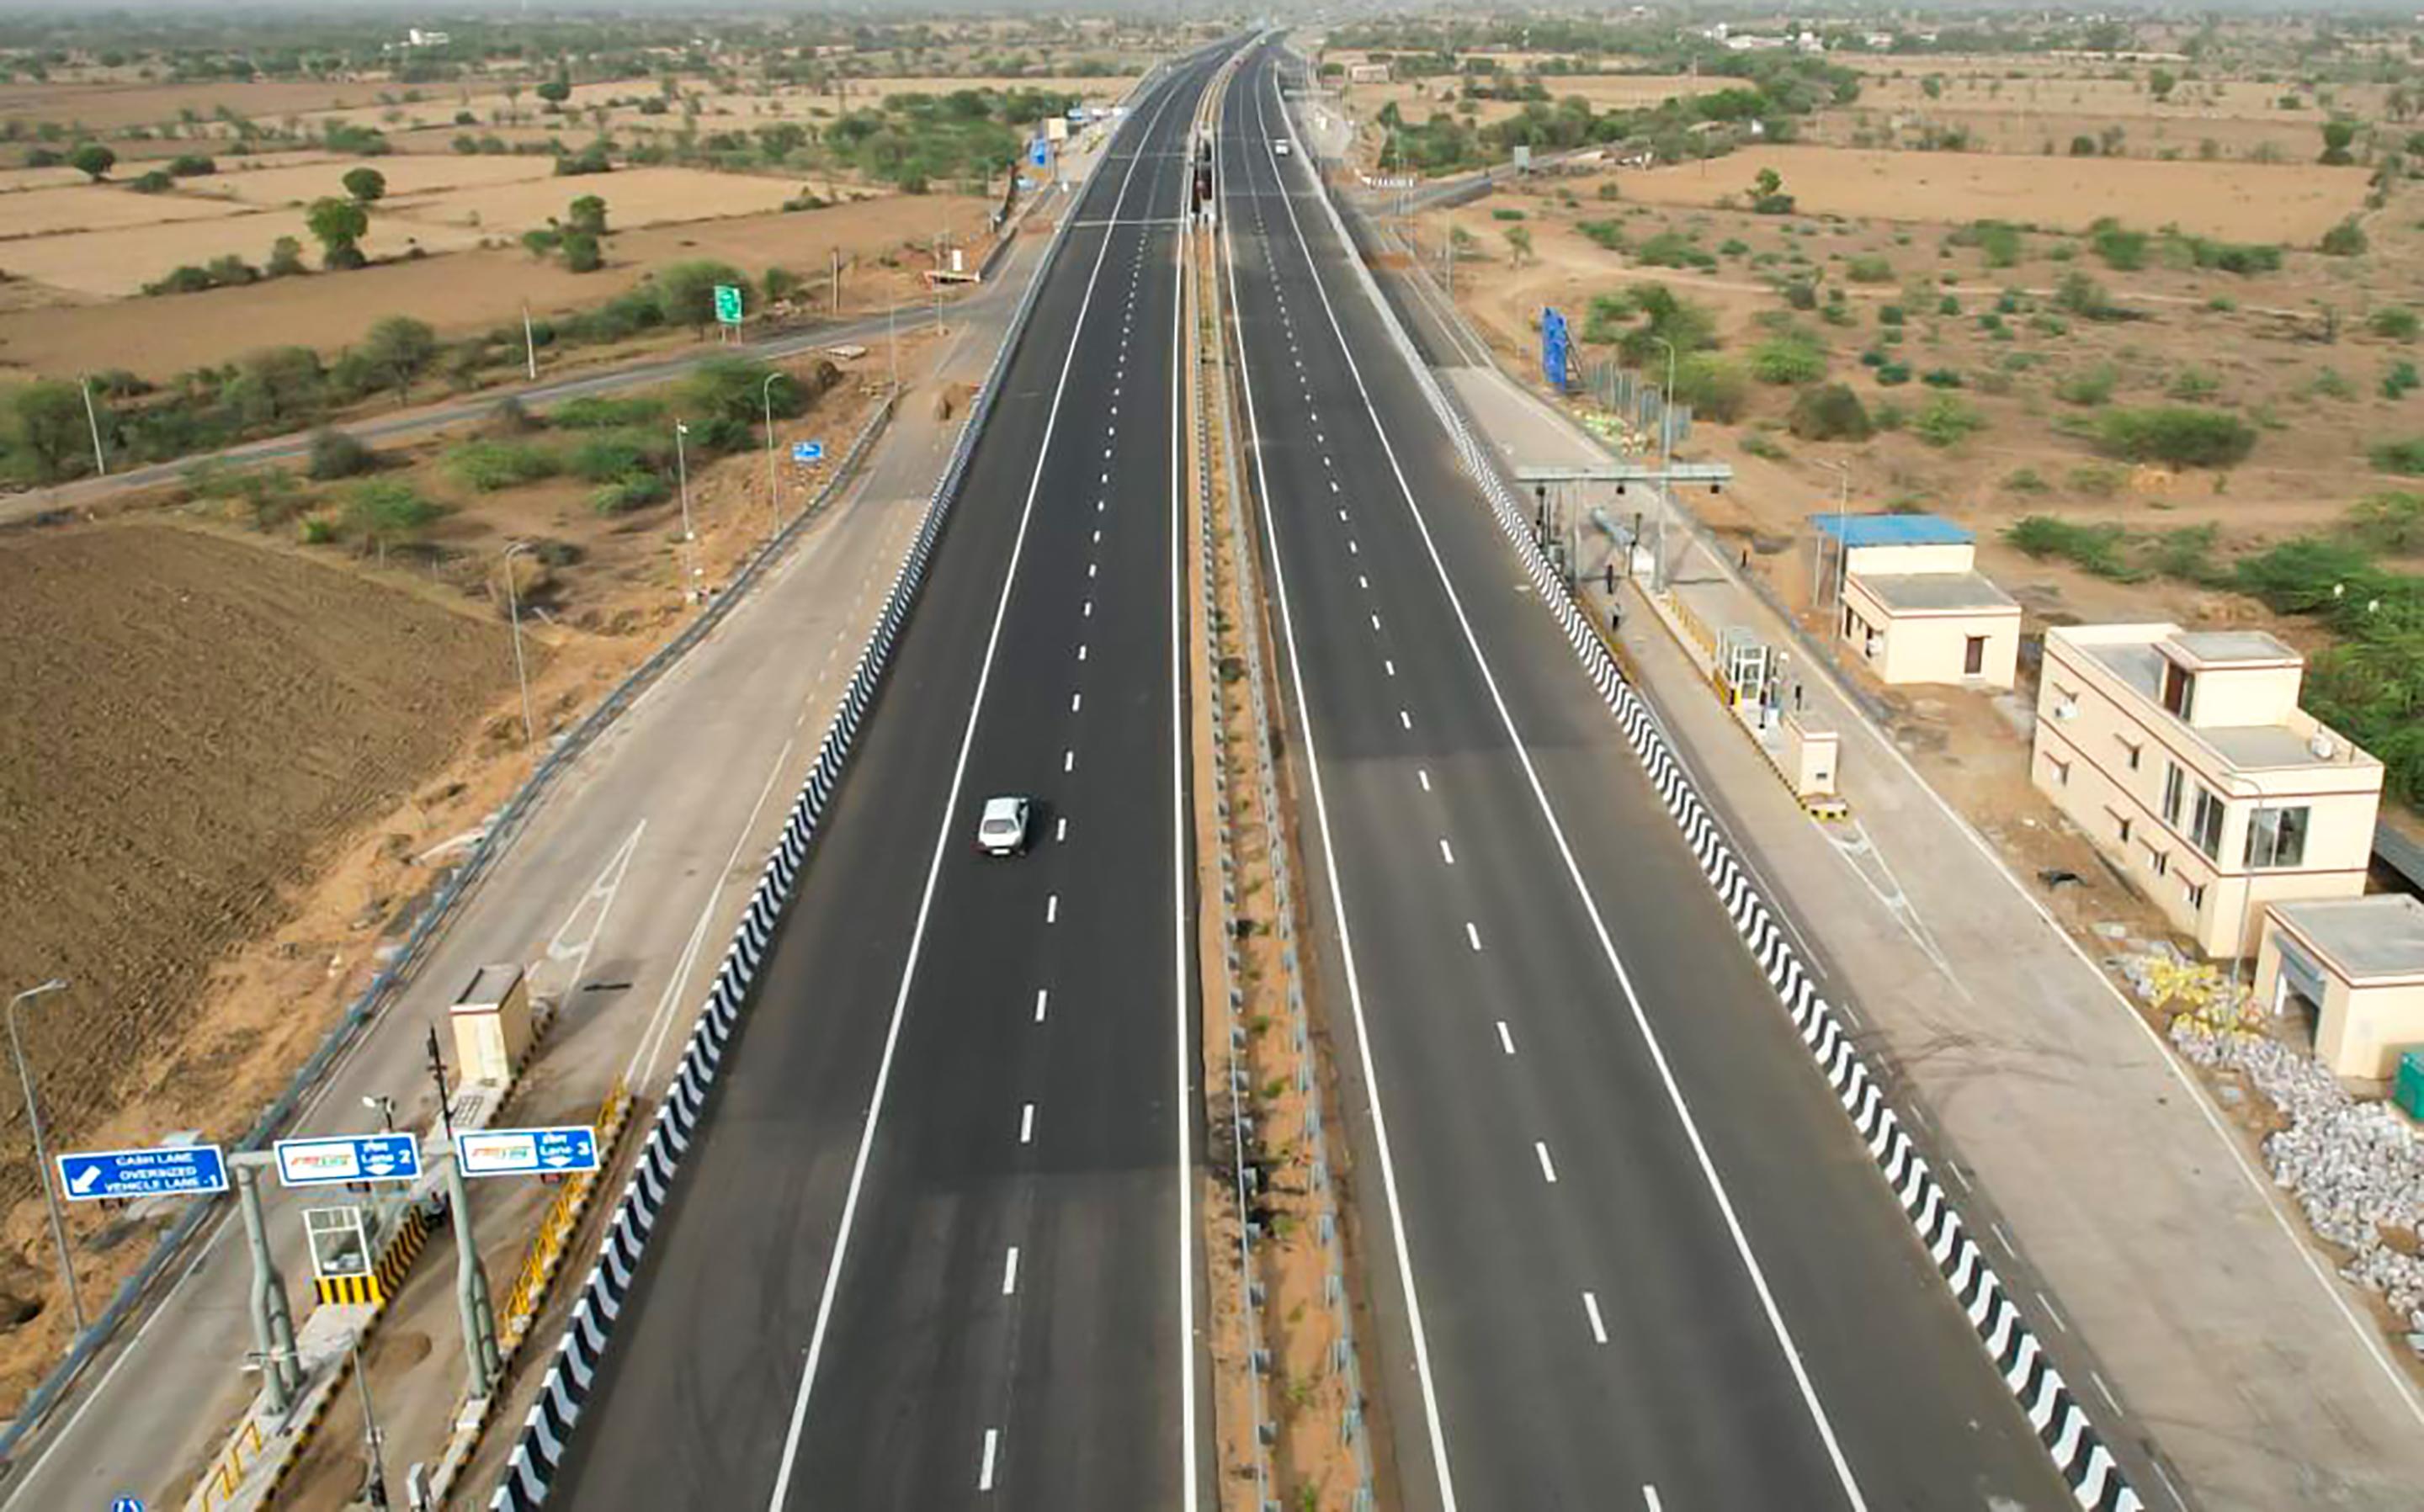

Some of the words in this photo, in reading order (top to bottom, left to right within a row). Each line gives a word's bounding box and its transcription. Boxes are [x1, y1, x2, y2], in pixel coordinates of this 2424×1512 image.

[577, 1141, 591, 1155] 3
[115, 1154, 155, 1165] CASH
[157, 1153, 194, 1164] LANE
[398, 1149, 412, 1165] 2
[104, 1180, 160, 1193] VEHICLE
[164, 1177, 199, 1189] LANE
